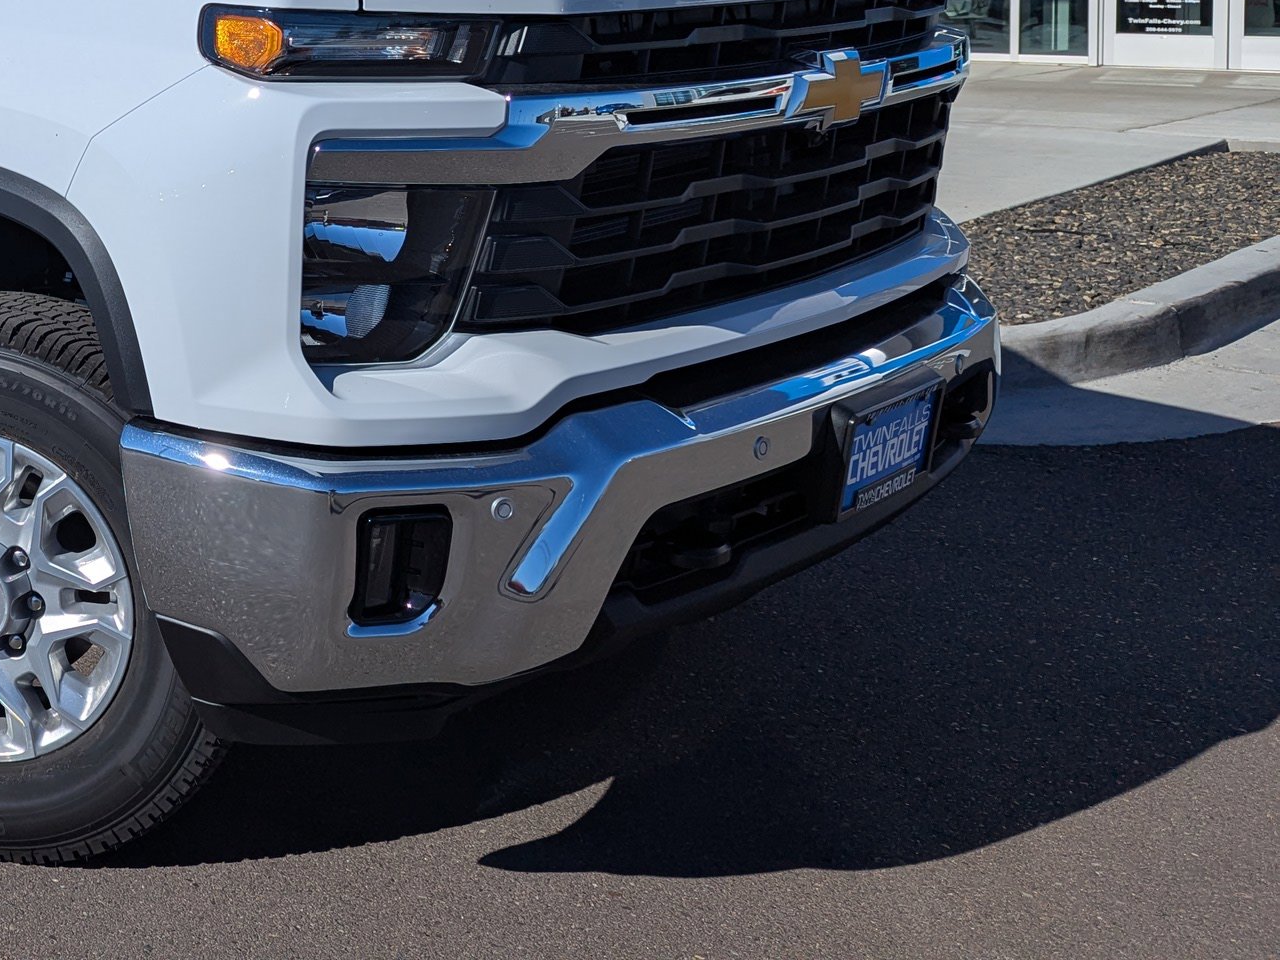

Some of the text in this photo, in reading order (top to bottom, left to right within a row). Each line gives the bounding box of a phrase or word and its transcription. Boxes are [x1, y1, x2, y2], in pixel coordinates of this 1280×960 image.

[1127, 17, 1201, 25] TwinFalls-Chevy.com
[854, 403, 932, 454] TWINFALLS
[847, 421, 928, 485] CHEVROLET
[875, 468, 917, 503] CHEVROLET
